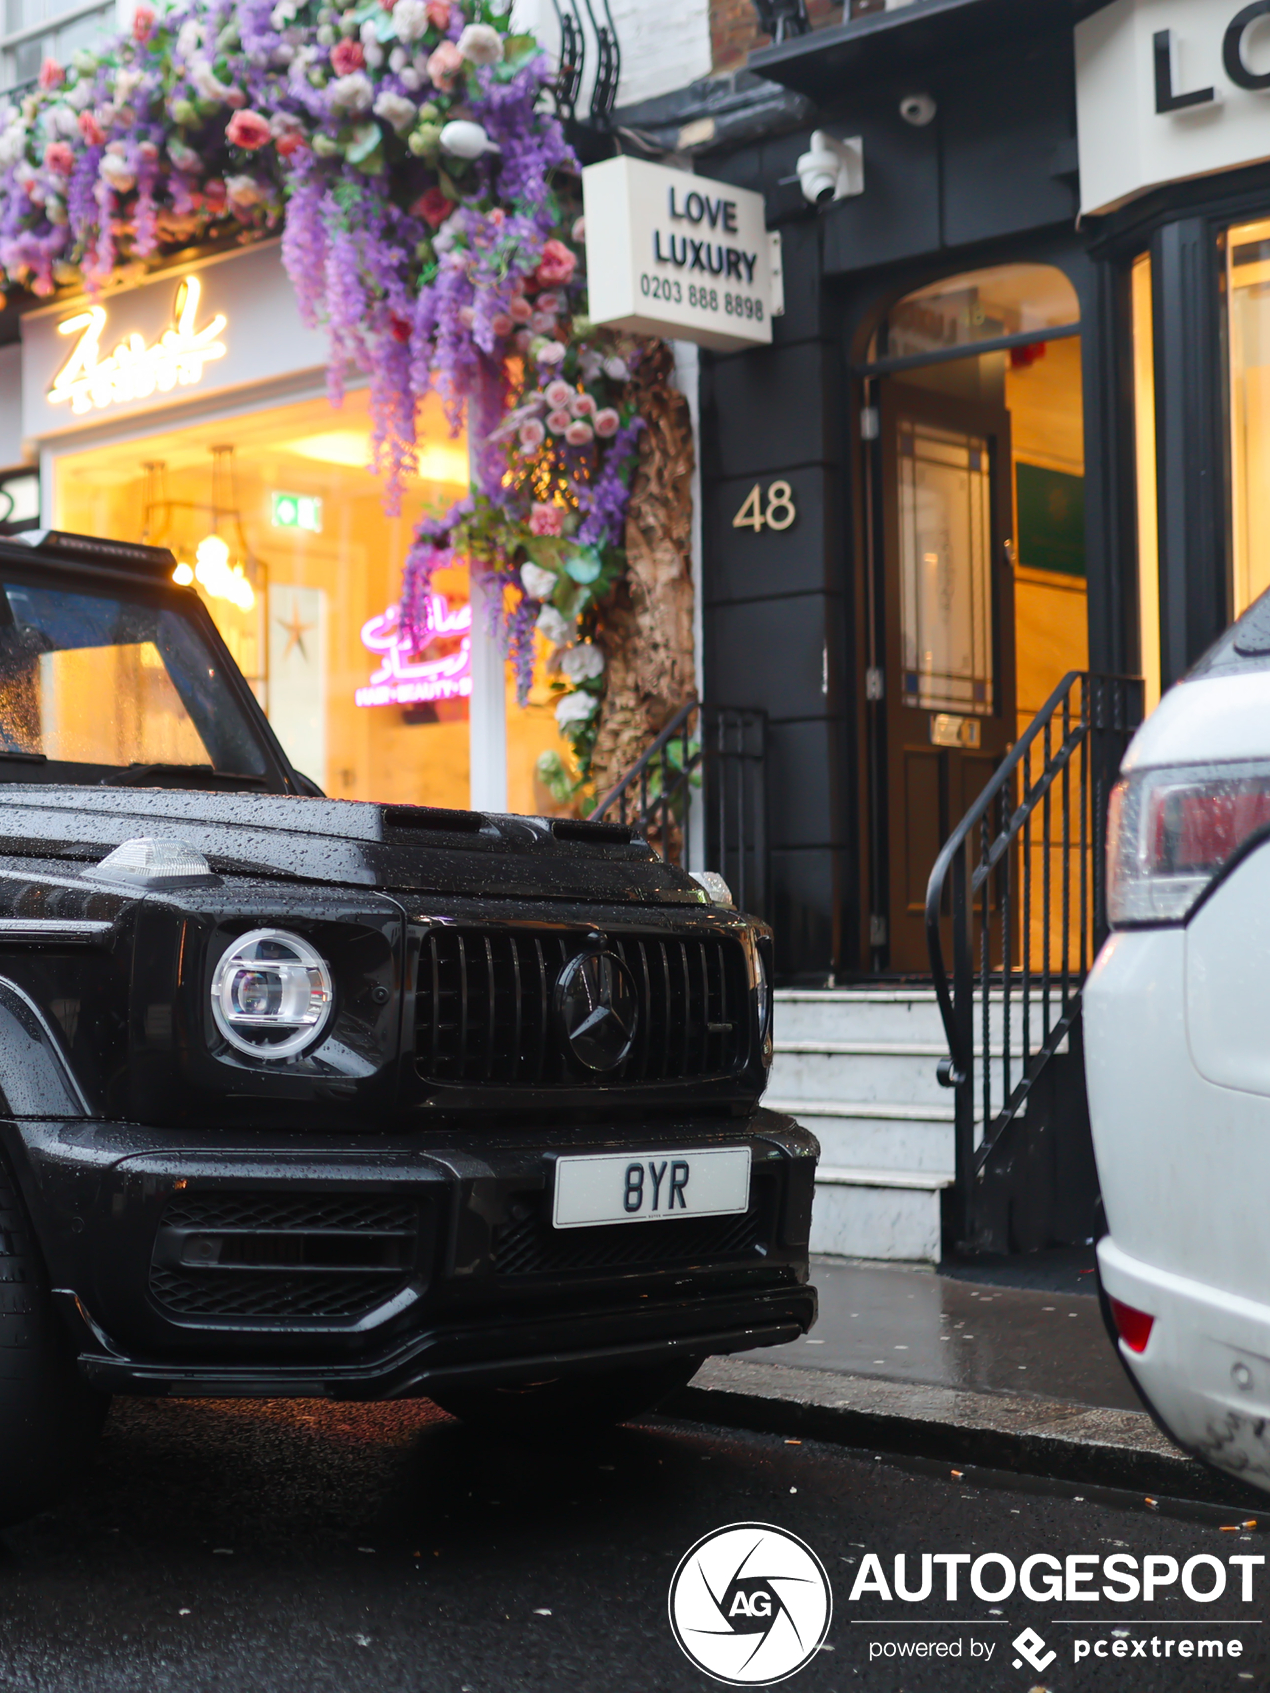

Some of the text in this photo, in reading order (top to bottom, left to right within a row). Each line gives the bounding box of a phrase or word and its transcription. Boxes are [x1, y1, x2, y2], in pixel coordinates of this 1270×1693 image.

[668, 186, 739, 234] LOVE
[654, 230, 757, 284] LUXURY
[641, 274, 764, 322] 0203 888 8898
[733, 480, 796, 533] 48
[623, 1160, 690, 1213] 8YR
